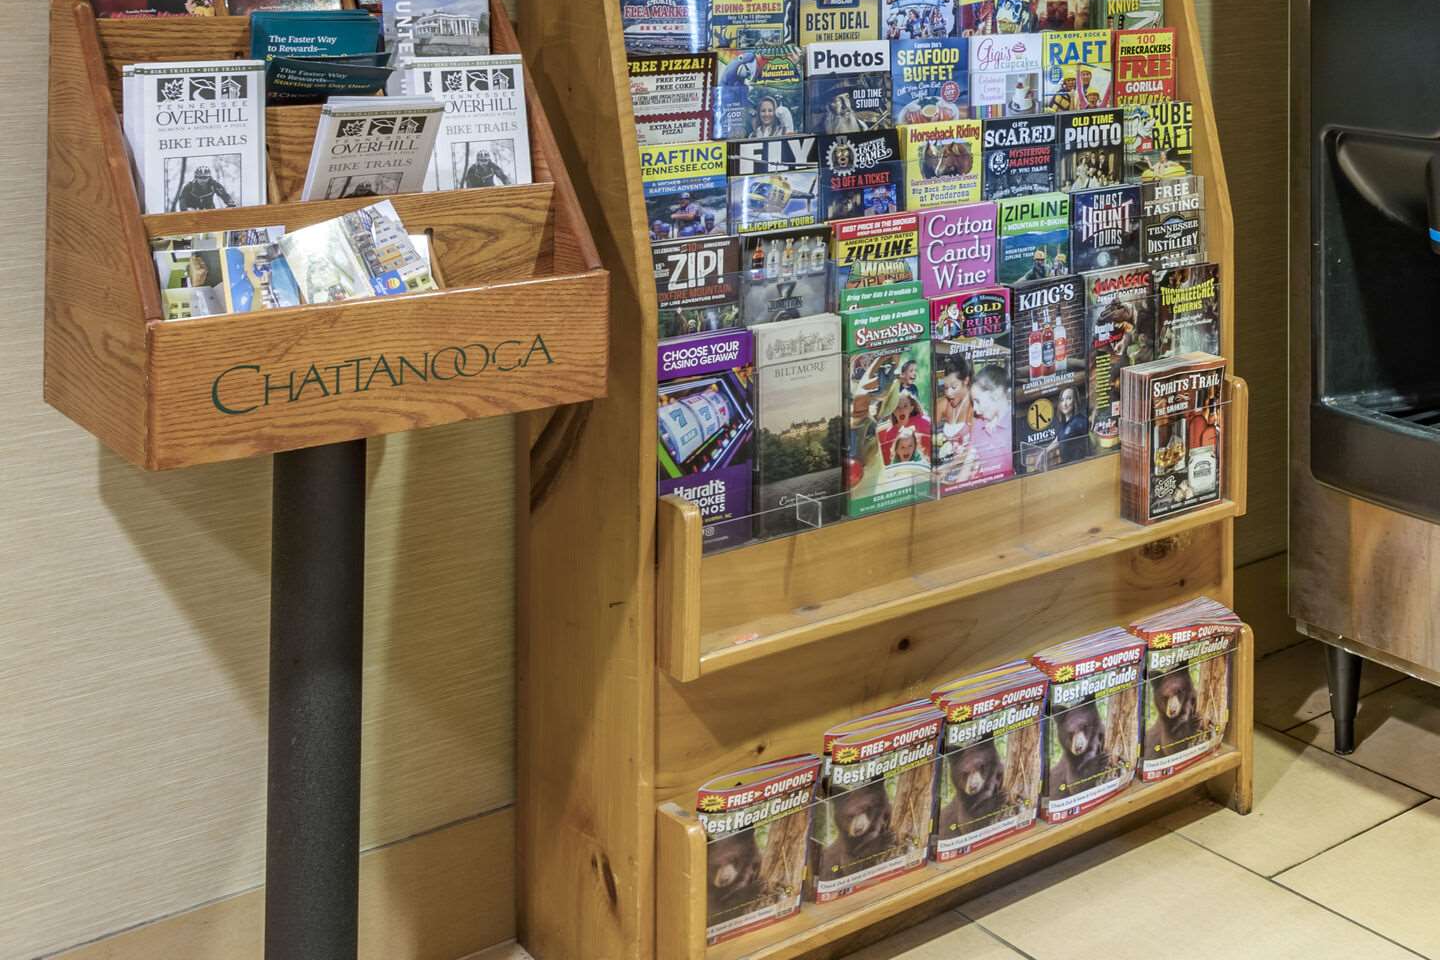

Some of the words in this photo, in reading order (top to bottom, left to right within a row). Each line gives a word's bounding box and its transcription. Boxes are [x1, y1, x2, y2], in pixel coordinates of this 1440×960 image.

[1107, 0, 1138, 15] KNIVES
[806, 12, 838, 31] BEST
[840, 12, 869, 30] DEAL
[288, 35, 314, 43] Faster
[1137, 34, 1156, 45] 100
[813, 49, 884, 69] Photos
[897, 48, 960, 66] SEAFOOD
[976, 38, 1012, 70] Gigi's
[1049, 40, 1107, 65] RAFT
[1120, 44, 1172, 55] FIRECRACKERS
[903, 65, 954, 82] BUFFET
[1120, 58, 1172, 78] FREE
[853, 88, 865, 99] OLD
[867, 88, 882, 98] TIME
[1125, 81, 1164, 93] GORILLA
[855, 98, 880, 108] STUDIO
[156, 108, 248, 126] OVERHILL
[1072, 115, 1092, 127] OLD
[1094, 113, 1114, 125] TIME
[160, 138, 192, 150] BIKE
[195, 134, 247, 147] TRAILS
[910, 127, 955, 142] Horseback
[956, 125, 980, 140] Riding
[984, 125, 1055, 148] SCARED
[1064, 123, 1121, 150] PHOTO
[641, 147, 722, 165] RAFTING
[739, 137, 816, 174] FLY
[640, 161, 723, 176] TENNESSEE.COM
[1093, 191, 1122, 210] GHOST
[1154, 183, 1190, 200] FREE
[1005, 200, 1069, 222] ZIPLINE
[1144, 198, 1200, 217] TASTING
[928, 215, 993, 239] Cotton
[1082, 200, 1135, 240] HAUNT
[927, 235, 992, 264] Candy
[1093, 231, 1122, 249] TOURS
[1148, 232, 1198, 253] DISTILLERY
[844, 238, 912, 264] ZIPLINE
[668, 246, 724, 291] ZIP!
[933, 264, 987, 289] Wine
[1018, 283, 1075, 312] KING'S
[1160, 278, 1216, 306] TUCKALEECHEE
[662, 345, 708, 362] CHOOSE
[710, 340, 740, 355] YOUR
[663, 356, 699, 372] CASINO
[700, 351, 740, 367] GETAWAY
[774, 360, 825, 378] BILTMORE
[1153, 378, 1189, 398] SPIRITS
[1189, 372, 1220, 390] TRAIL
[1075, 660, 1096, 677] FREE
[1102, 648, 1140, 668] COUPONS
[1054, 682, 1080, 703] Best
[1080, 676, 1107, 695] Read
[1108, 667, 1137, 688] Guide
